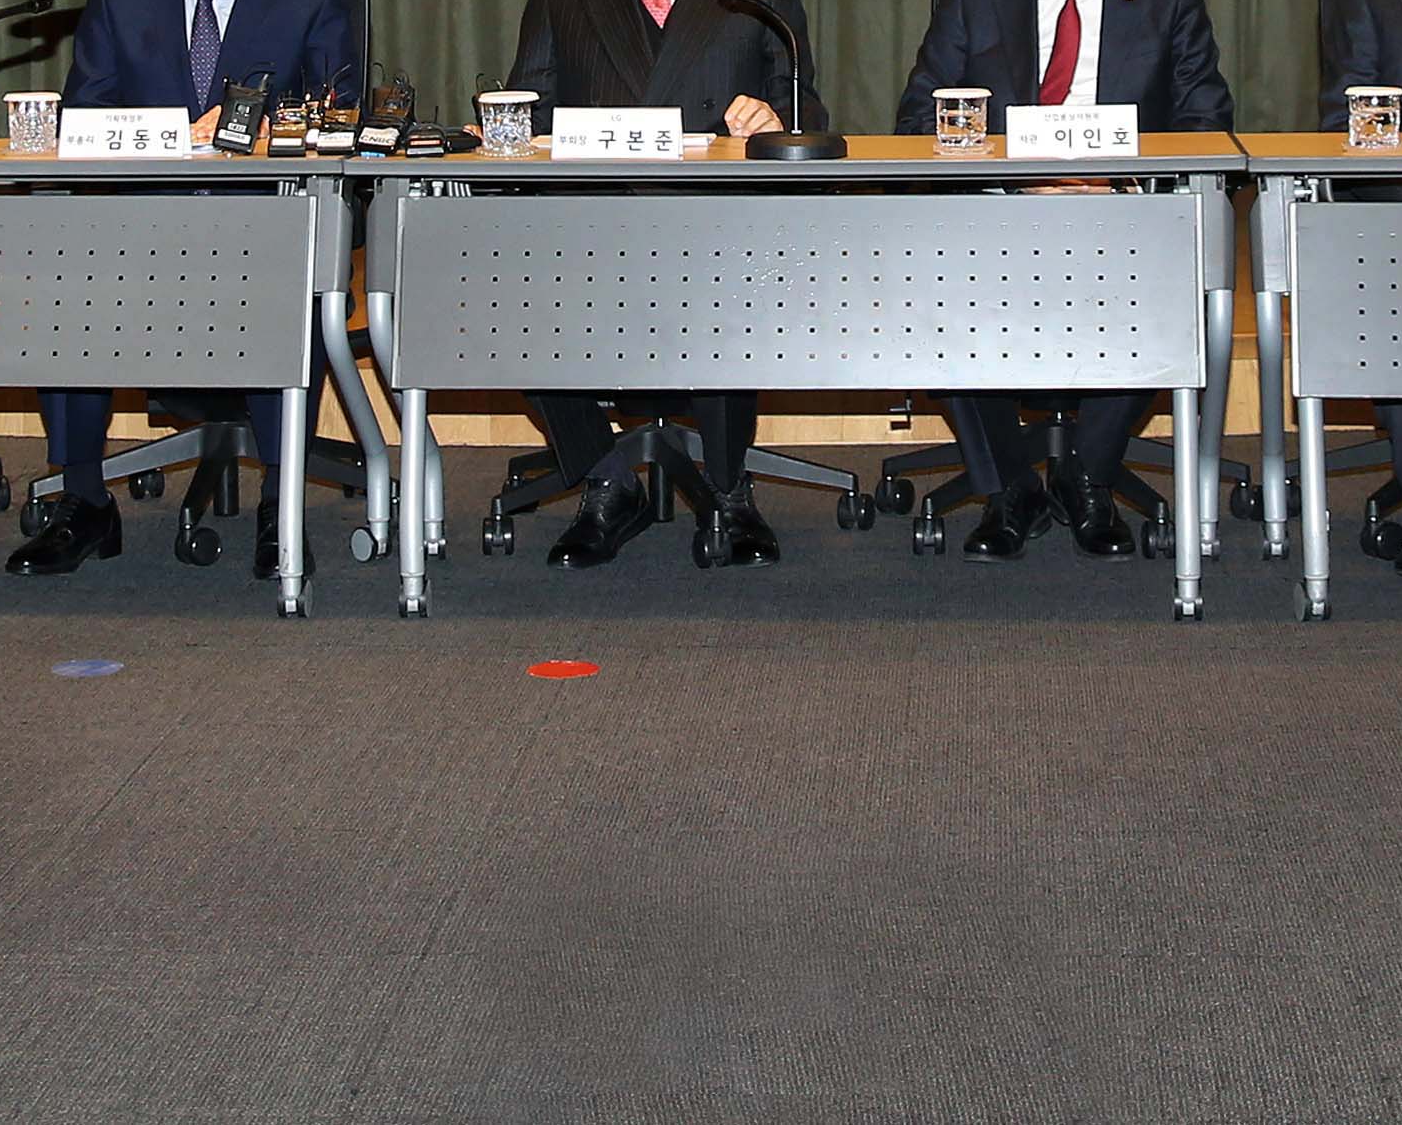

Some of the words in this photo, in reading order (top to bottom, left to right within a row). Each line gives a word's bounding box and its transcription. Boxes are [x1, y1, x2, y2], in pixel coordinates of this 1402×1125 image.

[105, 129, 178, 151] 김동연
[597, 129, 674, 152] 구본준
[1054, 127, 1132, 149] 이인호
